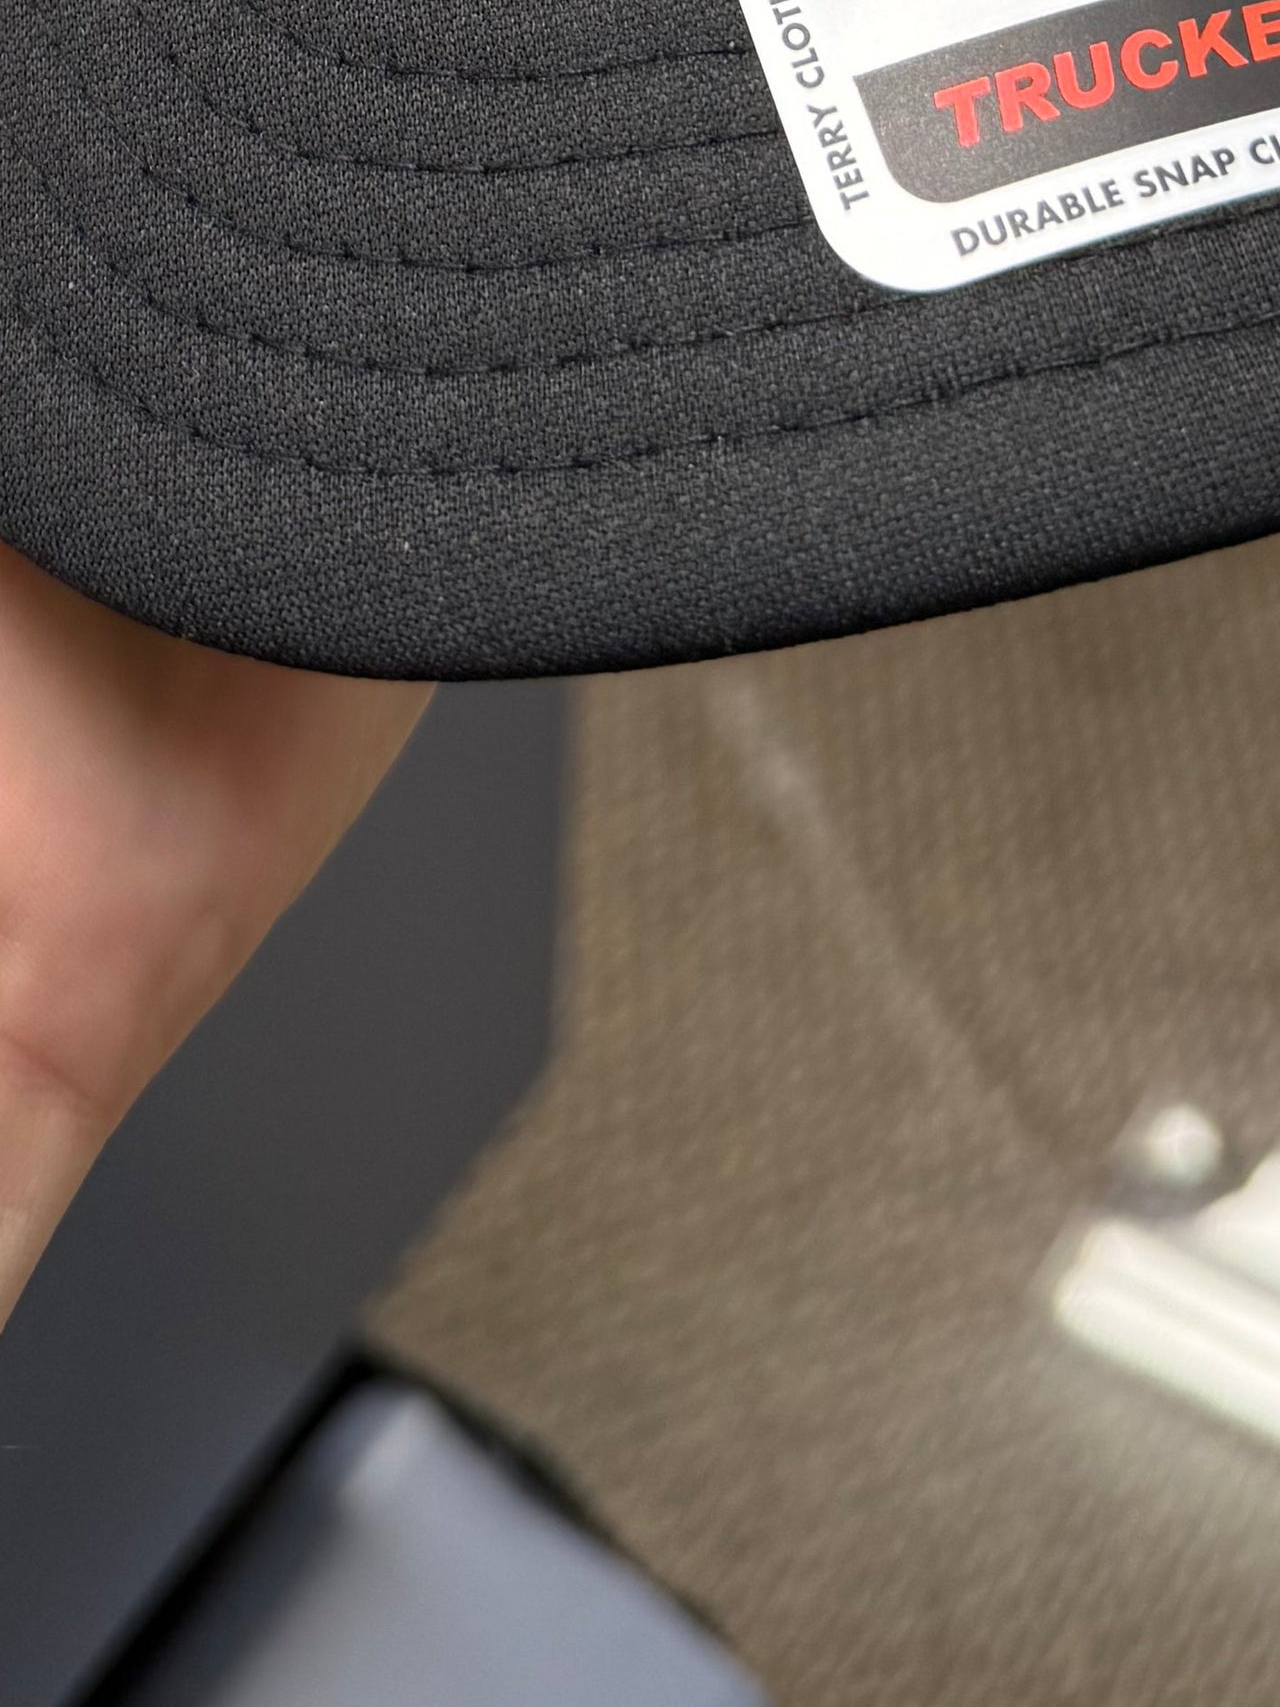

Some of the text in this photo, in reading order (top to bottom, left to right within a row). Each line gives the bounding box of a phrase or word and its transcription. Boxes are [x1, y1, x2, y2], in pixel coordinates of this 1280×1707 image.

[807, 104, 869, 211] TERRY
[951, 180, 1125, 257] DURABLE
[1133, 148, 1236, 200] SNAP
